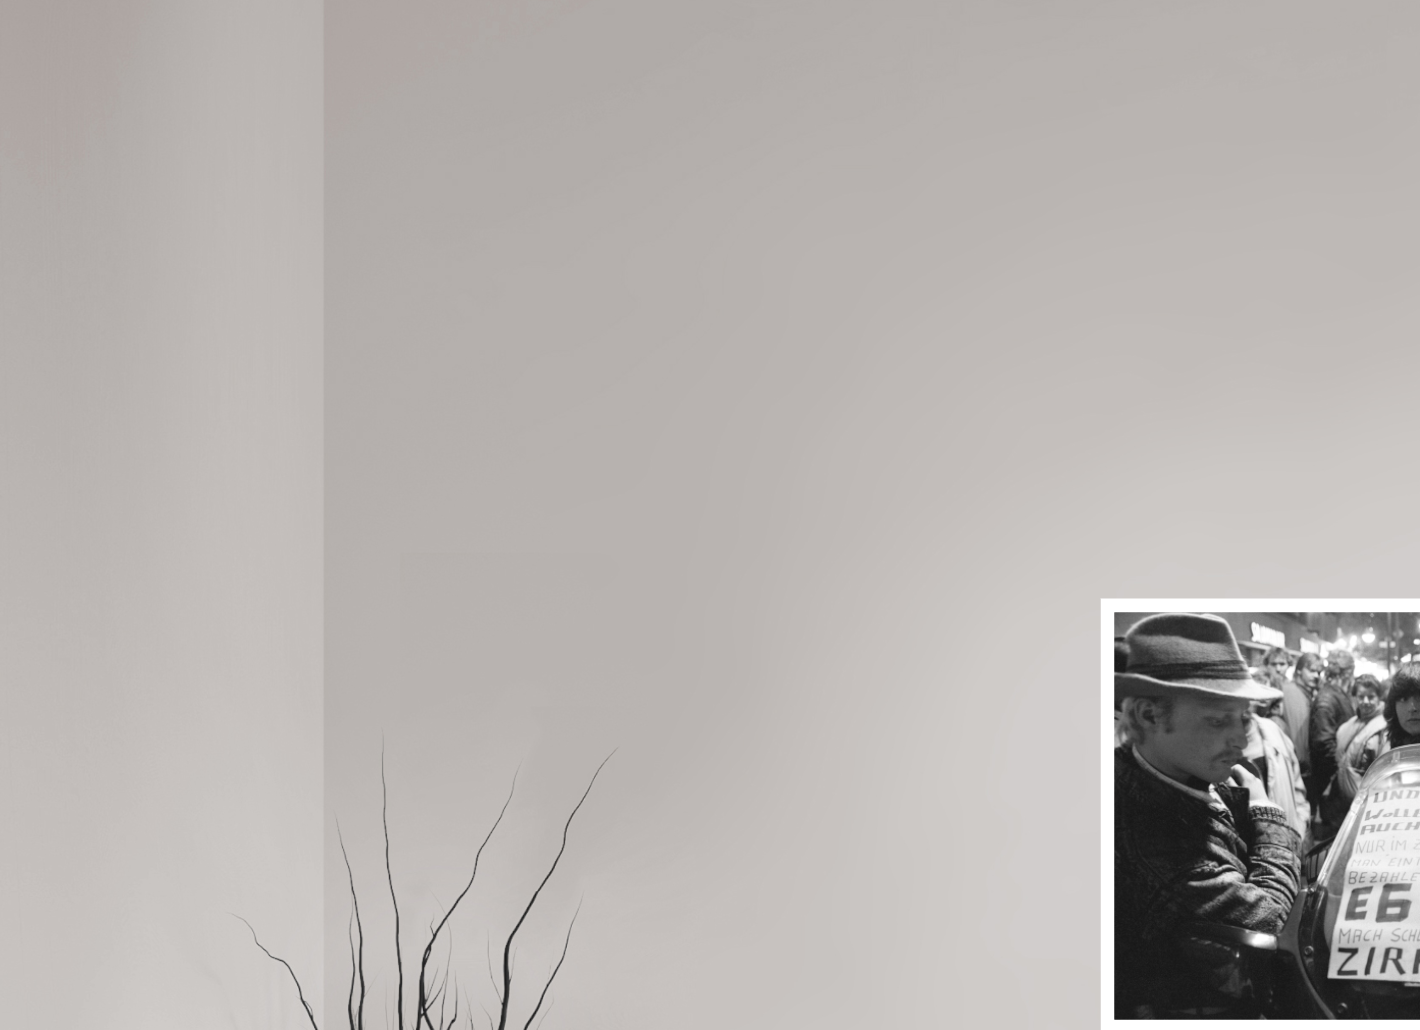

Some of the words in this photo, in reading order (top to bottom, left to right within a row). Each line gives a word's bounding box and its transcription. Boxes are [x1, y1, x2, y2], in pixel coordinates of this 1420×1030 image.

[1373, 790, 1420, 803] UND
[1360, 821, 1420, 836] AUCH
[1356, 839, 1386, 854] NUR
[1351, 858, 1381, 868] MAN
[1338, 928, 1382, 944] MACH
